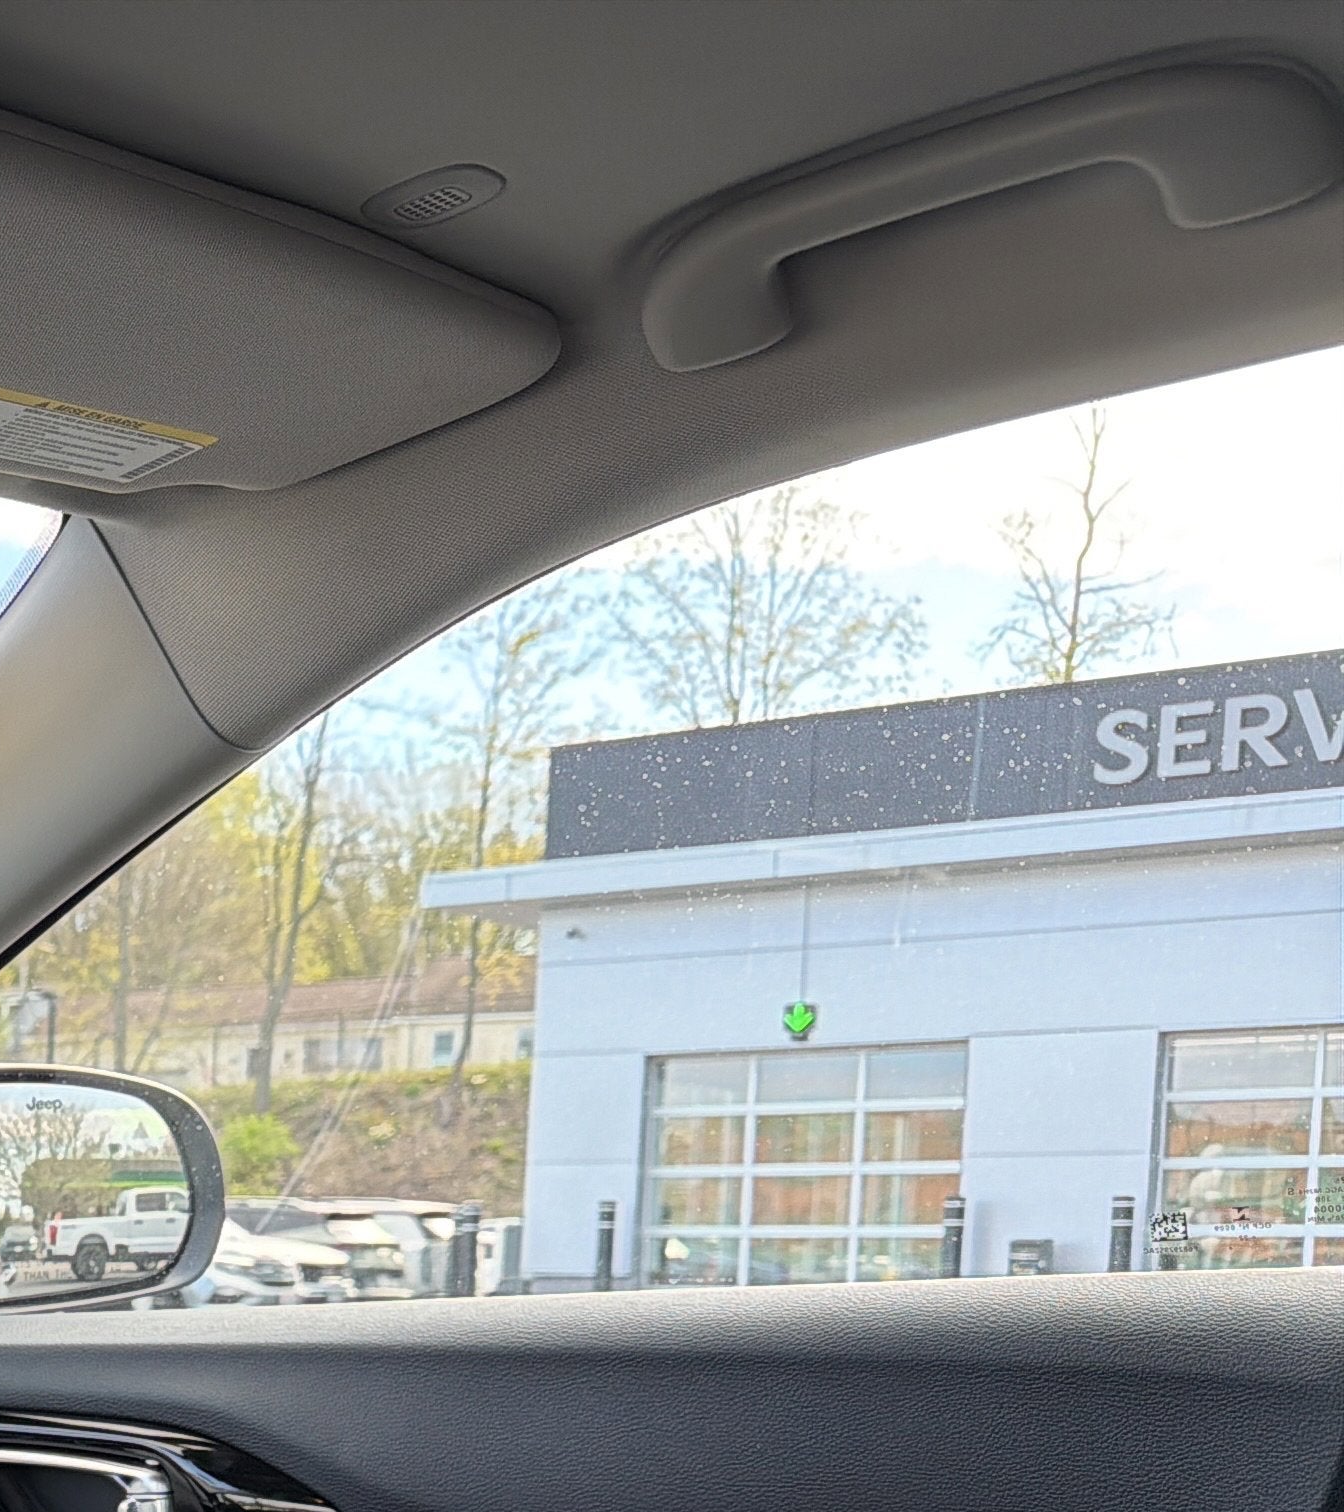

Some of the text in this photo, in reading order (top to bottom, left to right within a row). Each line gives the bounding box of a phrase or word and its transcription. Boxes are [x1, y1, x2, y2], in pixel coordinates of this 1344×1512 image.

[59, 404, 85, 417] MISE
[87, 411, 104, 420] EN
[26, 1096, 63, 1112] Jeep
